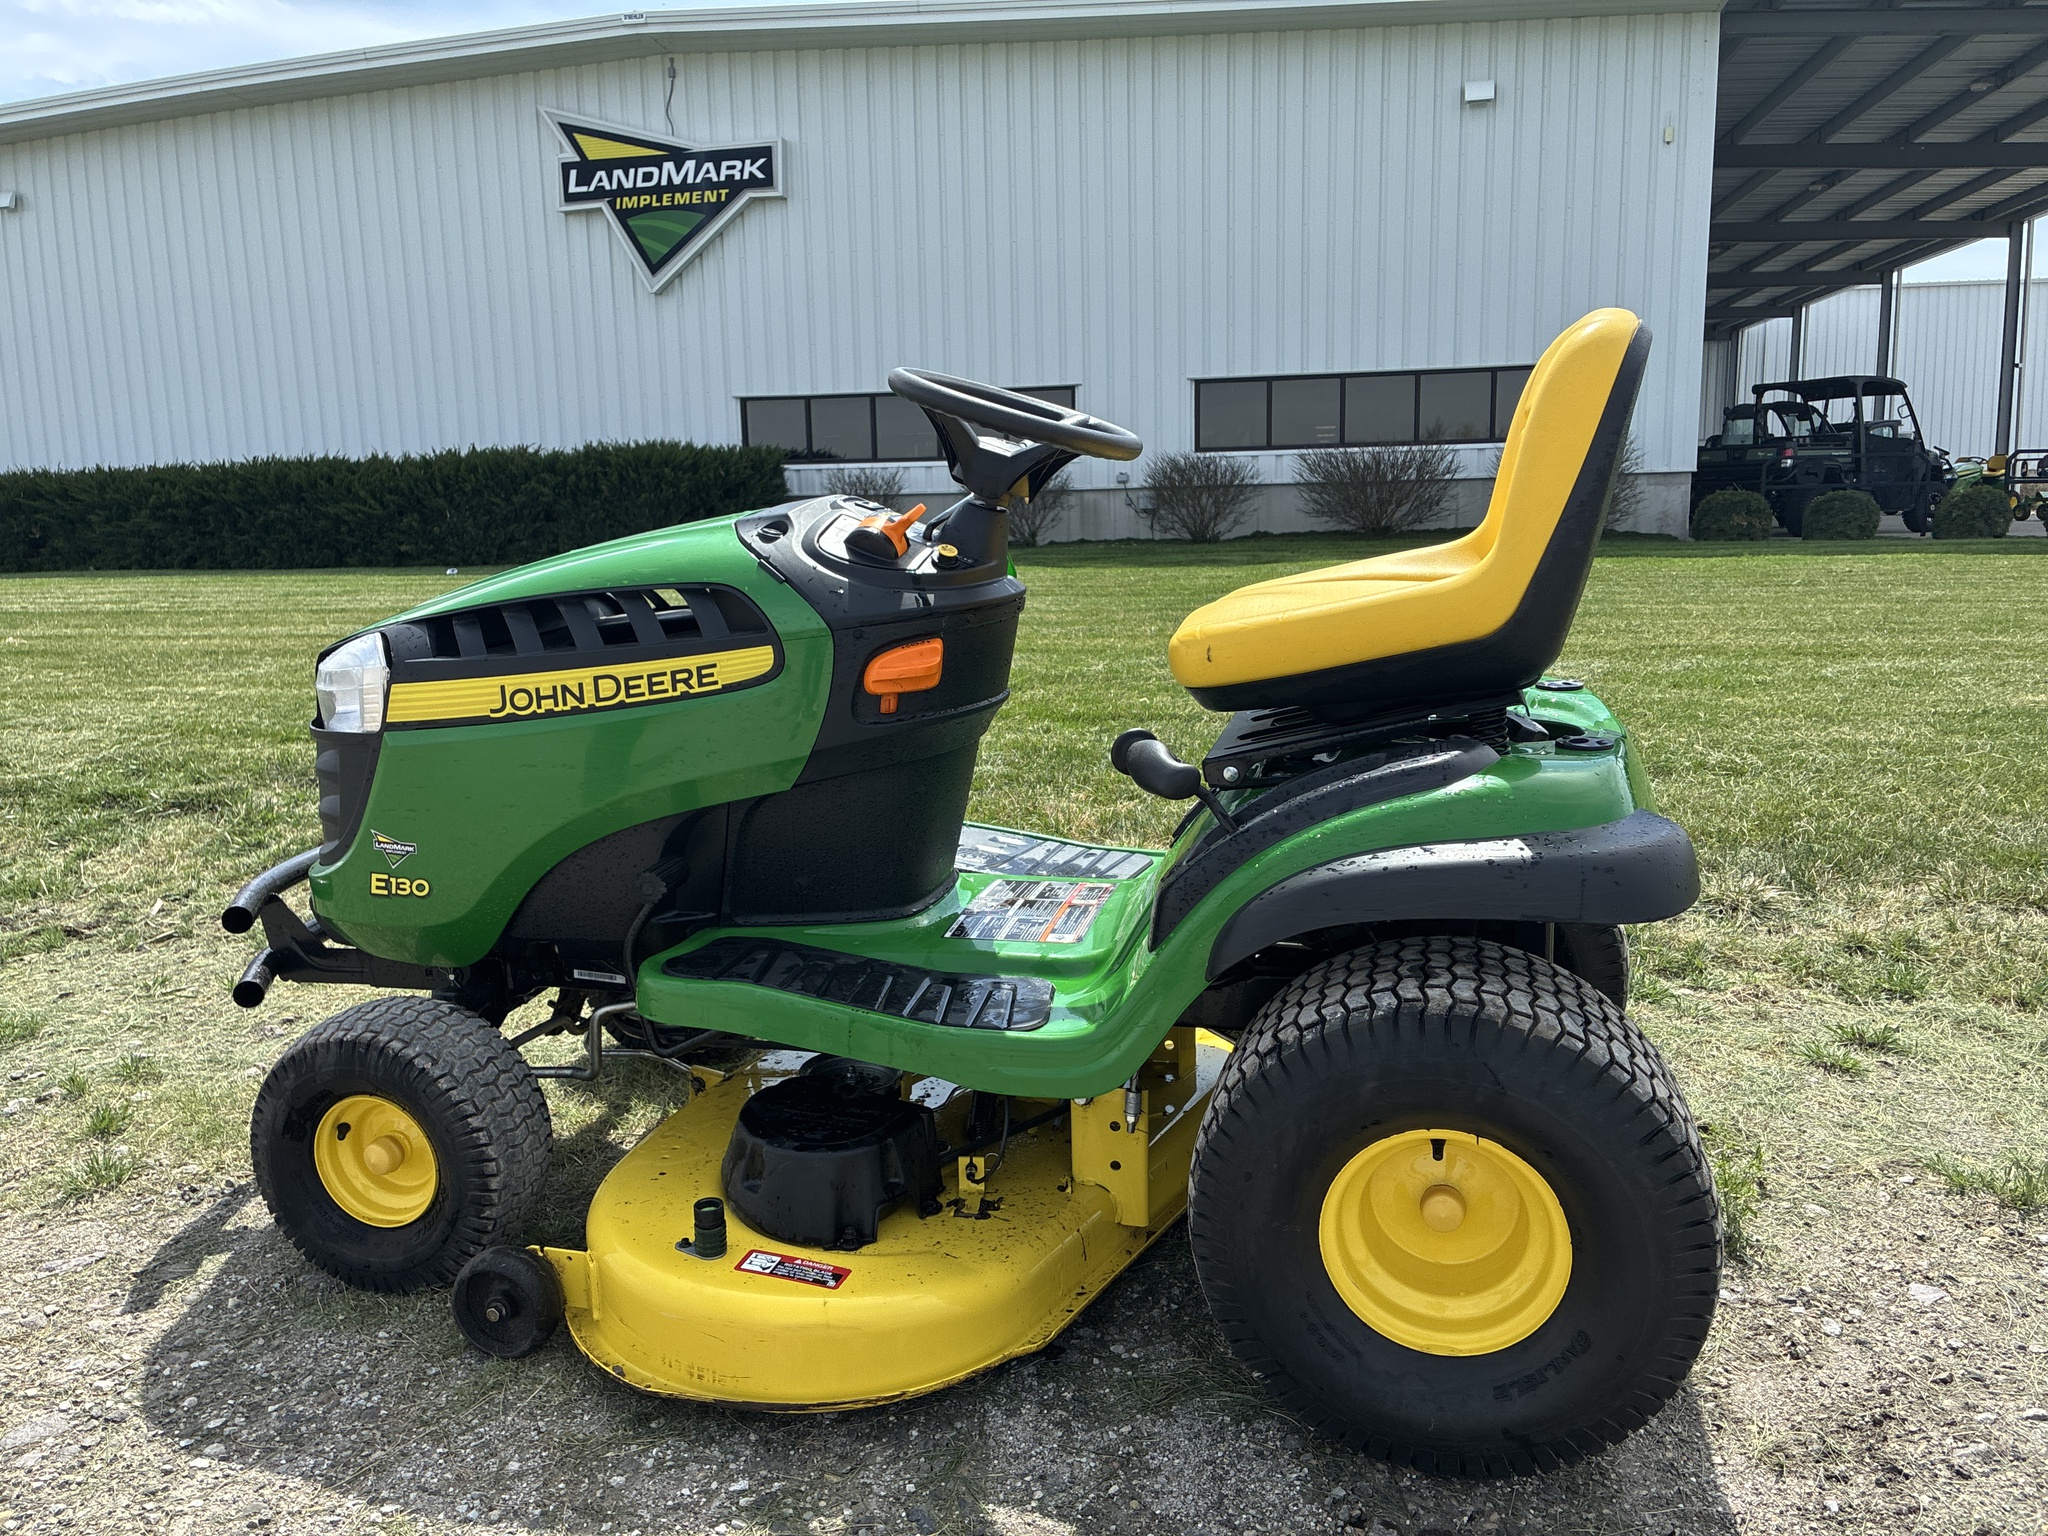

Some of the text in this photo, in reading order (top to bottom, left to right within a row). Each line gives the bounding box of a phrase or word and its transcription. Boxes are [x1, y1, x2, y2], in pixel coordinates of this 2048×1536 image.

[567, 157, 768, 194] LANDMARK
[615, 188, 730, 210] IMPLEMENT
[489, 662, 721, 714] JOHN DEERE
[375, 841, 415, 852] LANDMARK
[370, 872, 430, 897] E130
[802, 1260, 834, 1271] DANGER
[1492, 1328, 1592, 1404] CARLISLE
